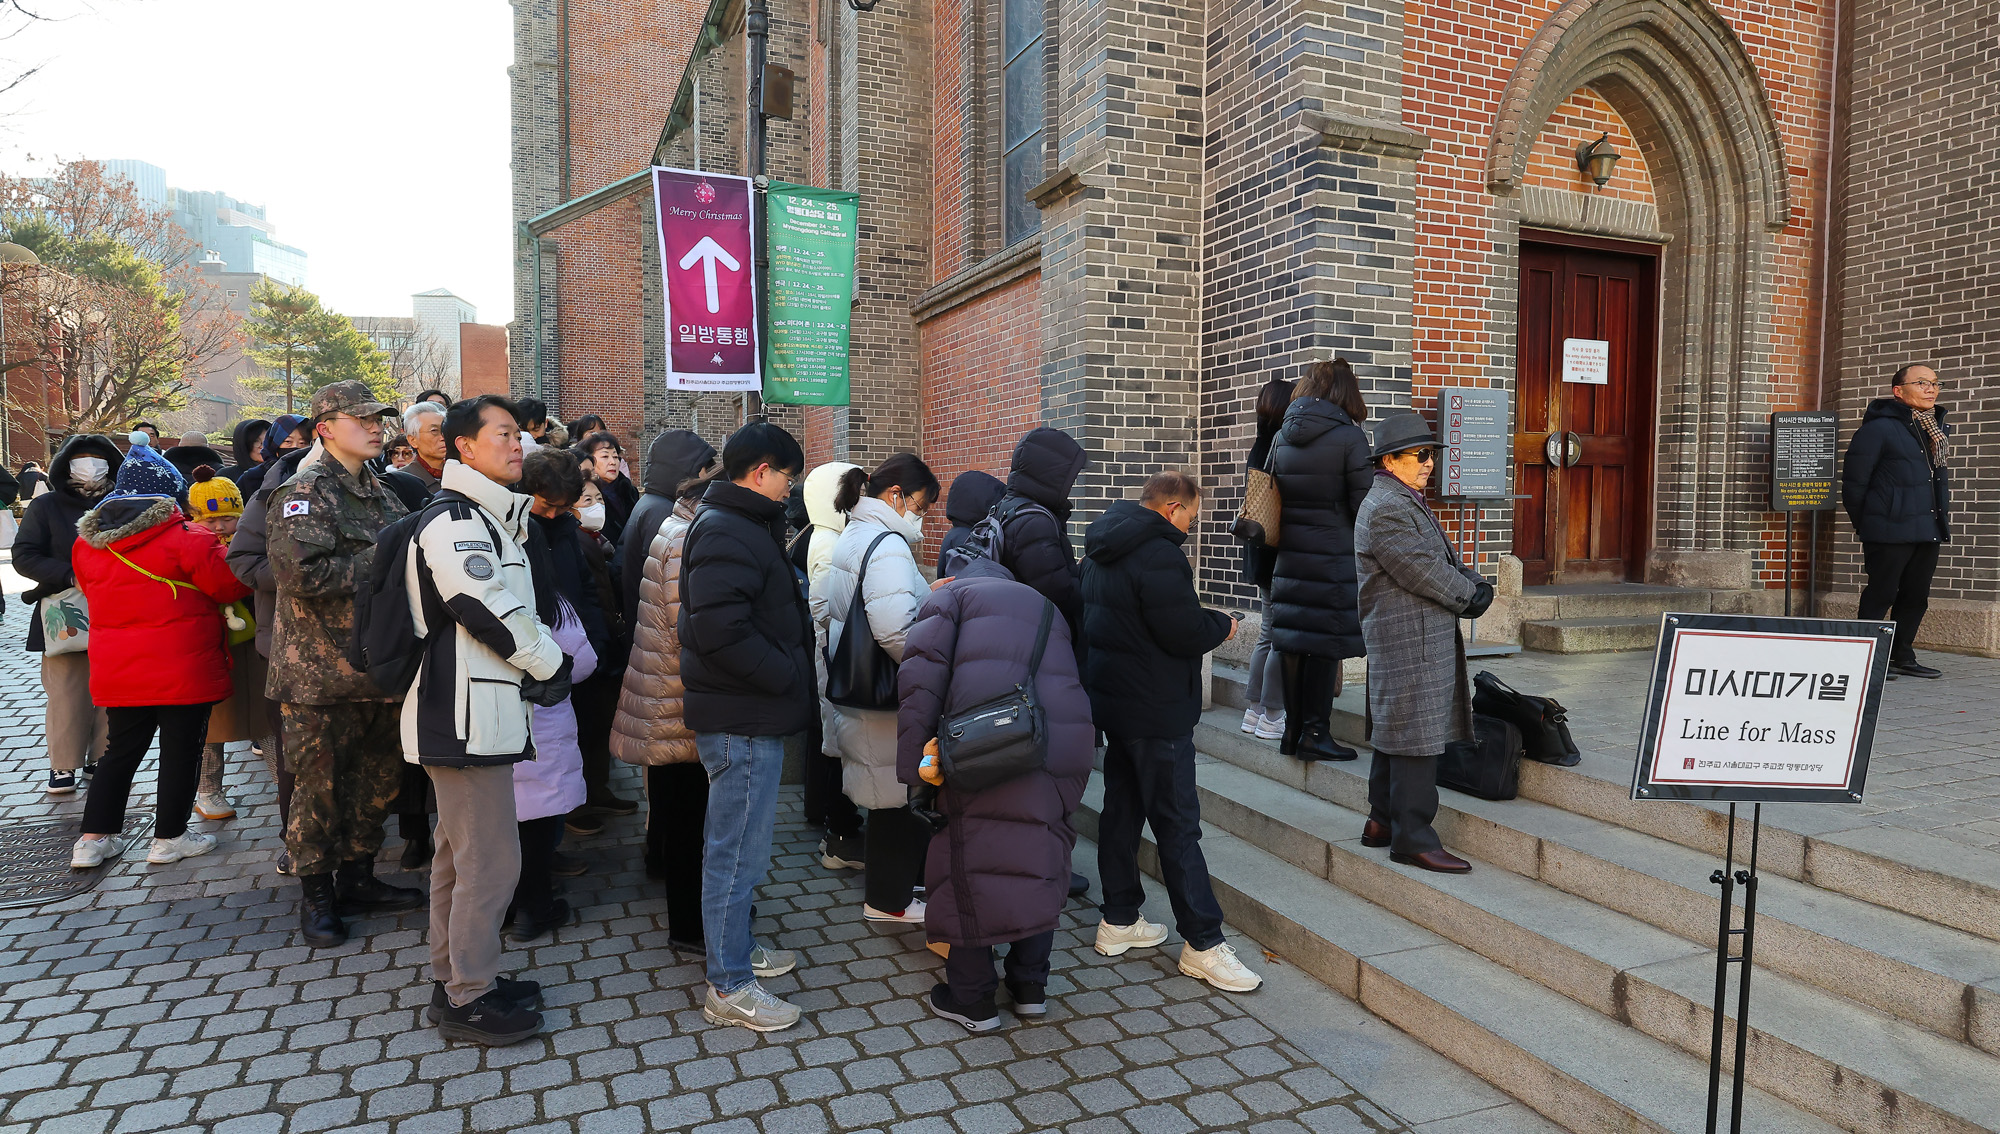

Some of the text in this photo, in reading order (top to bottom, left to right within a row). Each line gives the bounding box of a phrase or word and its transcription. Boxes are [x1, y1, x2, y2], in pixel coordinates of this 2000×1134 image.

[788, 196, 799, 206] 12.
[802, 198, 815, 208] 24.
[826, 202, 840, 212] 25.
[669, 206, 743, 220] Merry Christmas
[786, 205, 825, 219] 명동대성당
[782, 223, 847, 238] Myeongdong Cathedral
[789, 218, 818, 228] December
[679, 324, 748, 346] 일방통행
[1685, 668, 1849, 701] 미사대기열
[1680, 719, 1836, 744] Line for Mass
[1699, 760, 1721, 768] 천주교
[1786, 764, 1823, 772] 명동대성당
